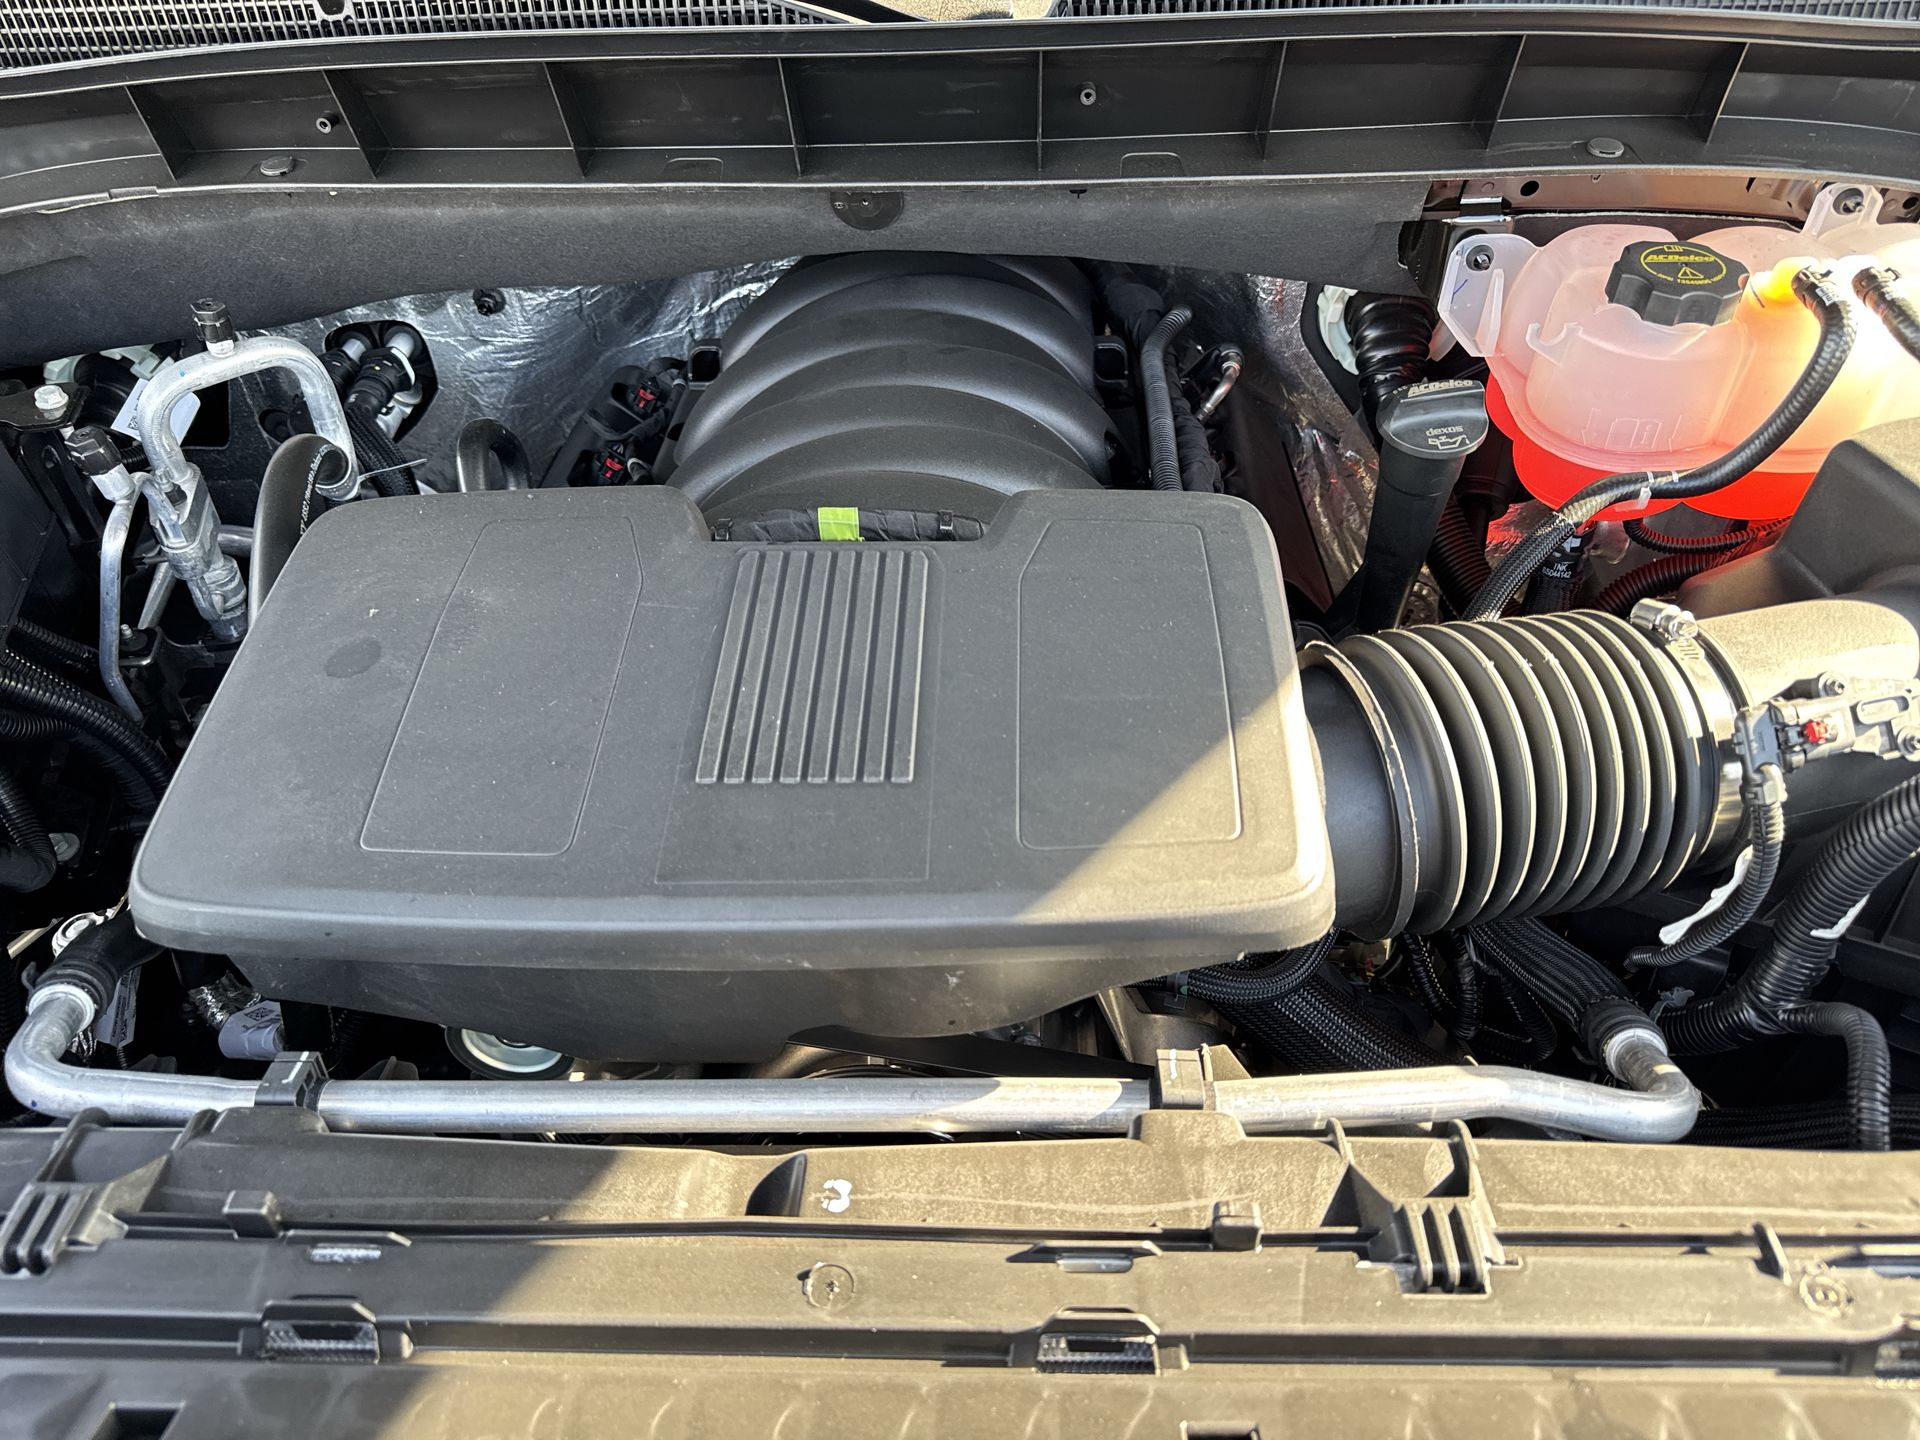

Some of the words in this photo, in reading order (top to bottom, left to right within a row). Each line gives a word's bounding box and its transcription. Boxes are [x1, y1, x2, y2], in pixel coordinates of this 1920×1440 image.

[1645, 254, 1716, 262] ACDelco
[1408, 379, 1474, 397] ACDelco
[1425, 425, 1464, 436] dexos
